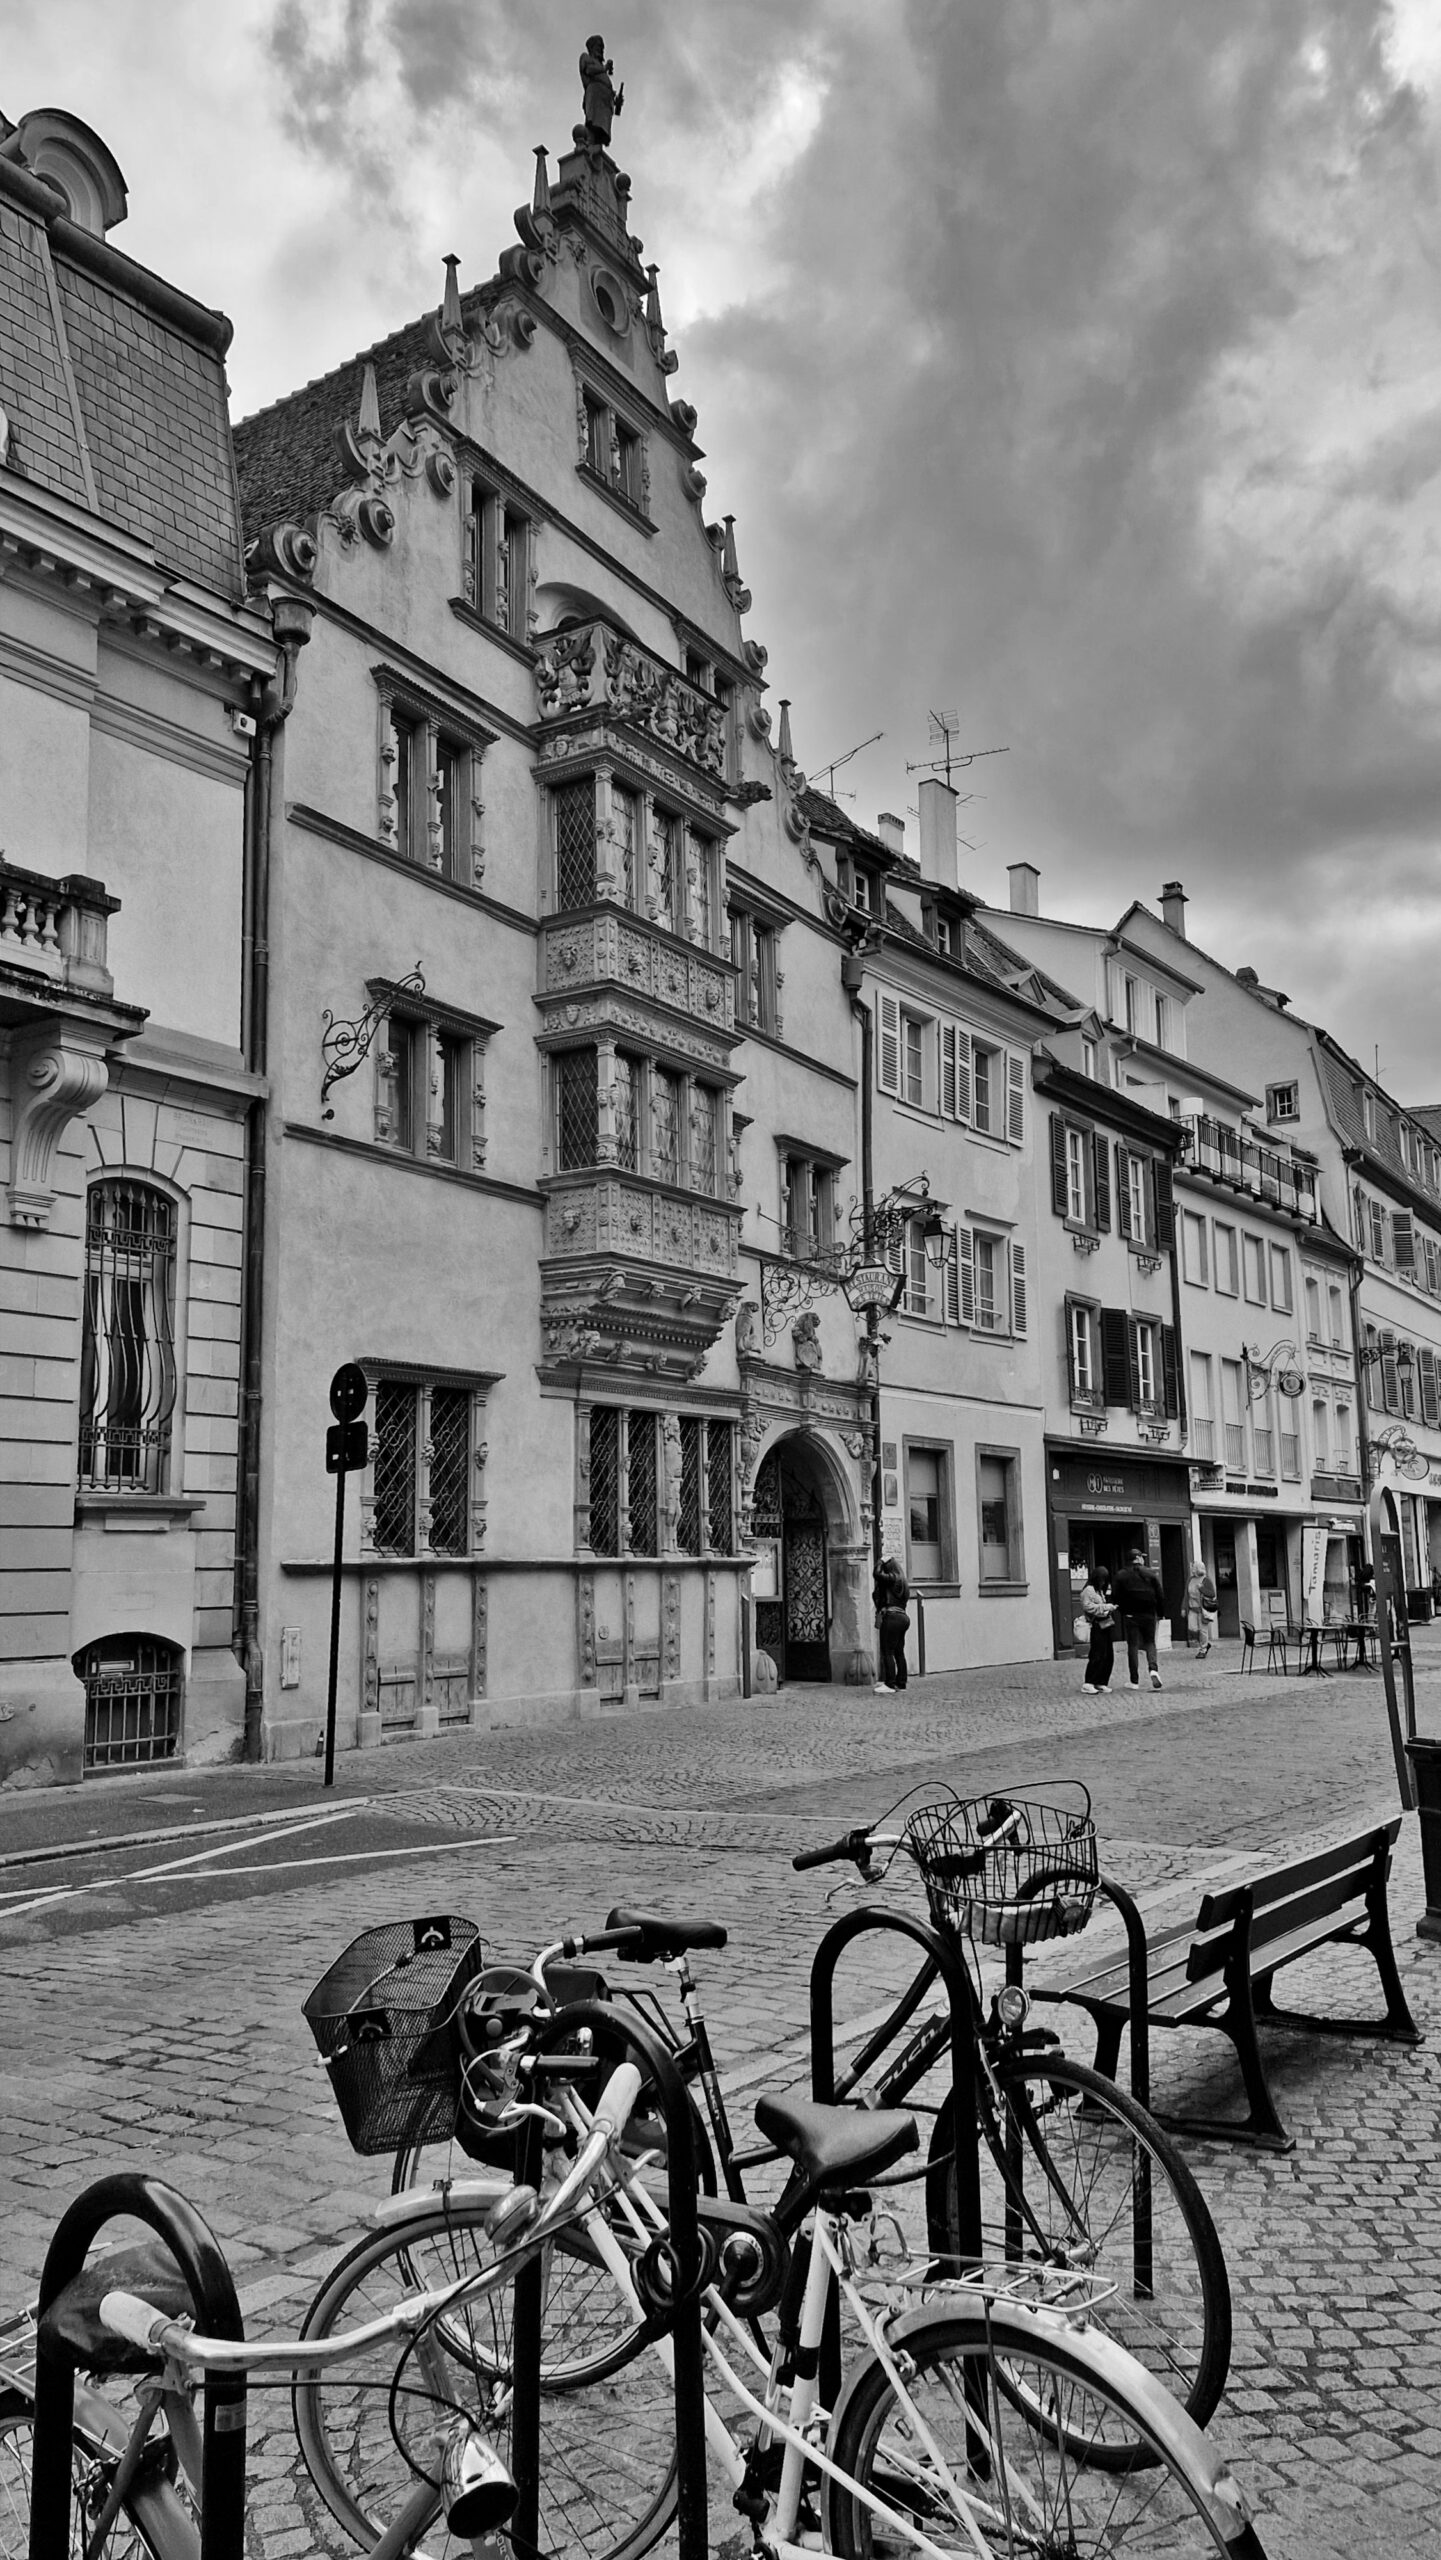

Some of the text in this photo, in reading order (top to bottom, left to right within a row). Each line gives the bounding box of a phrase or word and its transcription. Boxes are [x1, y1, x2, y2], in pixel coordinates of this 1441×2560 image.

[845, 1272, 898, 1291] RESTAURANT
[1308, 1531, 1321, 1596] Tamaris
[874, 2028, 938, 2102] Puch
